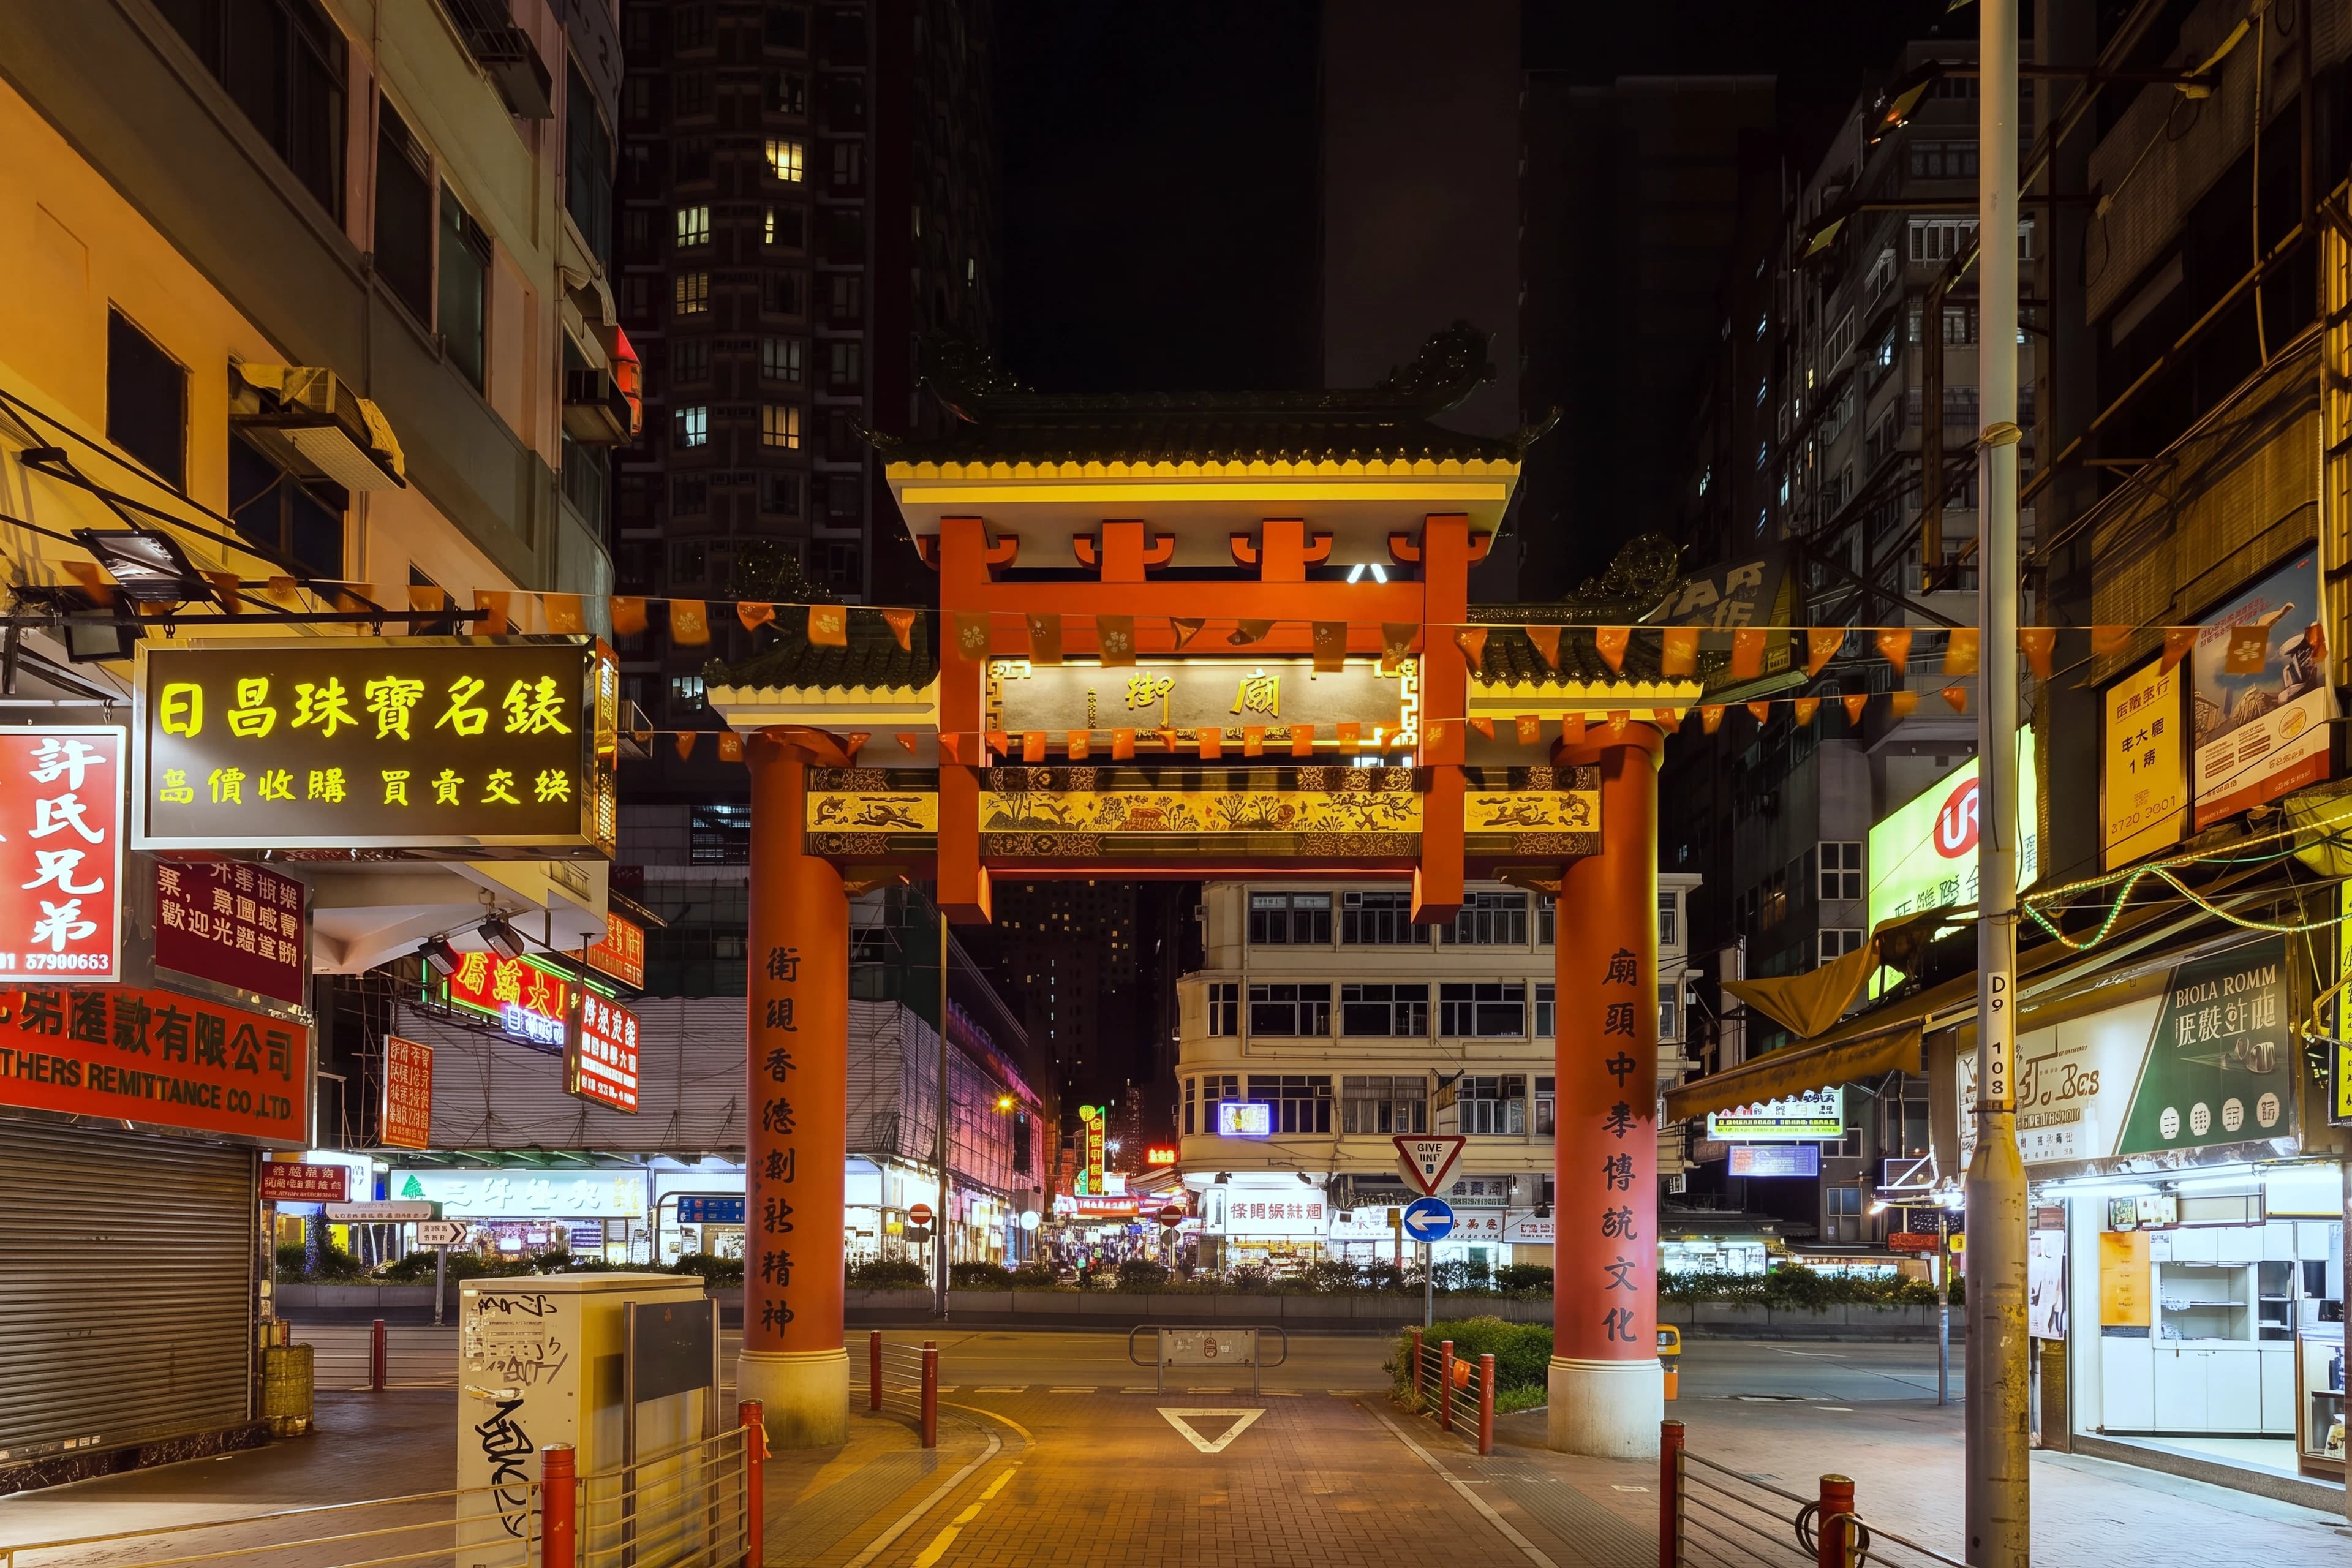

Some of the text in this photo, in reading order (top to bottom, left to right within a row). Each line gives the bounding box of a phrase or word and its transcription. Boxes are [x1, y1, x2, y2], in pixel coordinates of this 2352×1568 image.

[21, 737, 107, 952] 許氏兄弟
[85, 1062, 221, 1109] REMITTANCE
[1417, 1143, 1442, 1152] GIVE
